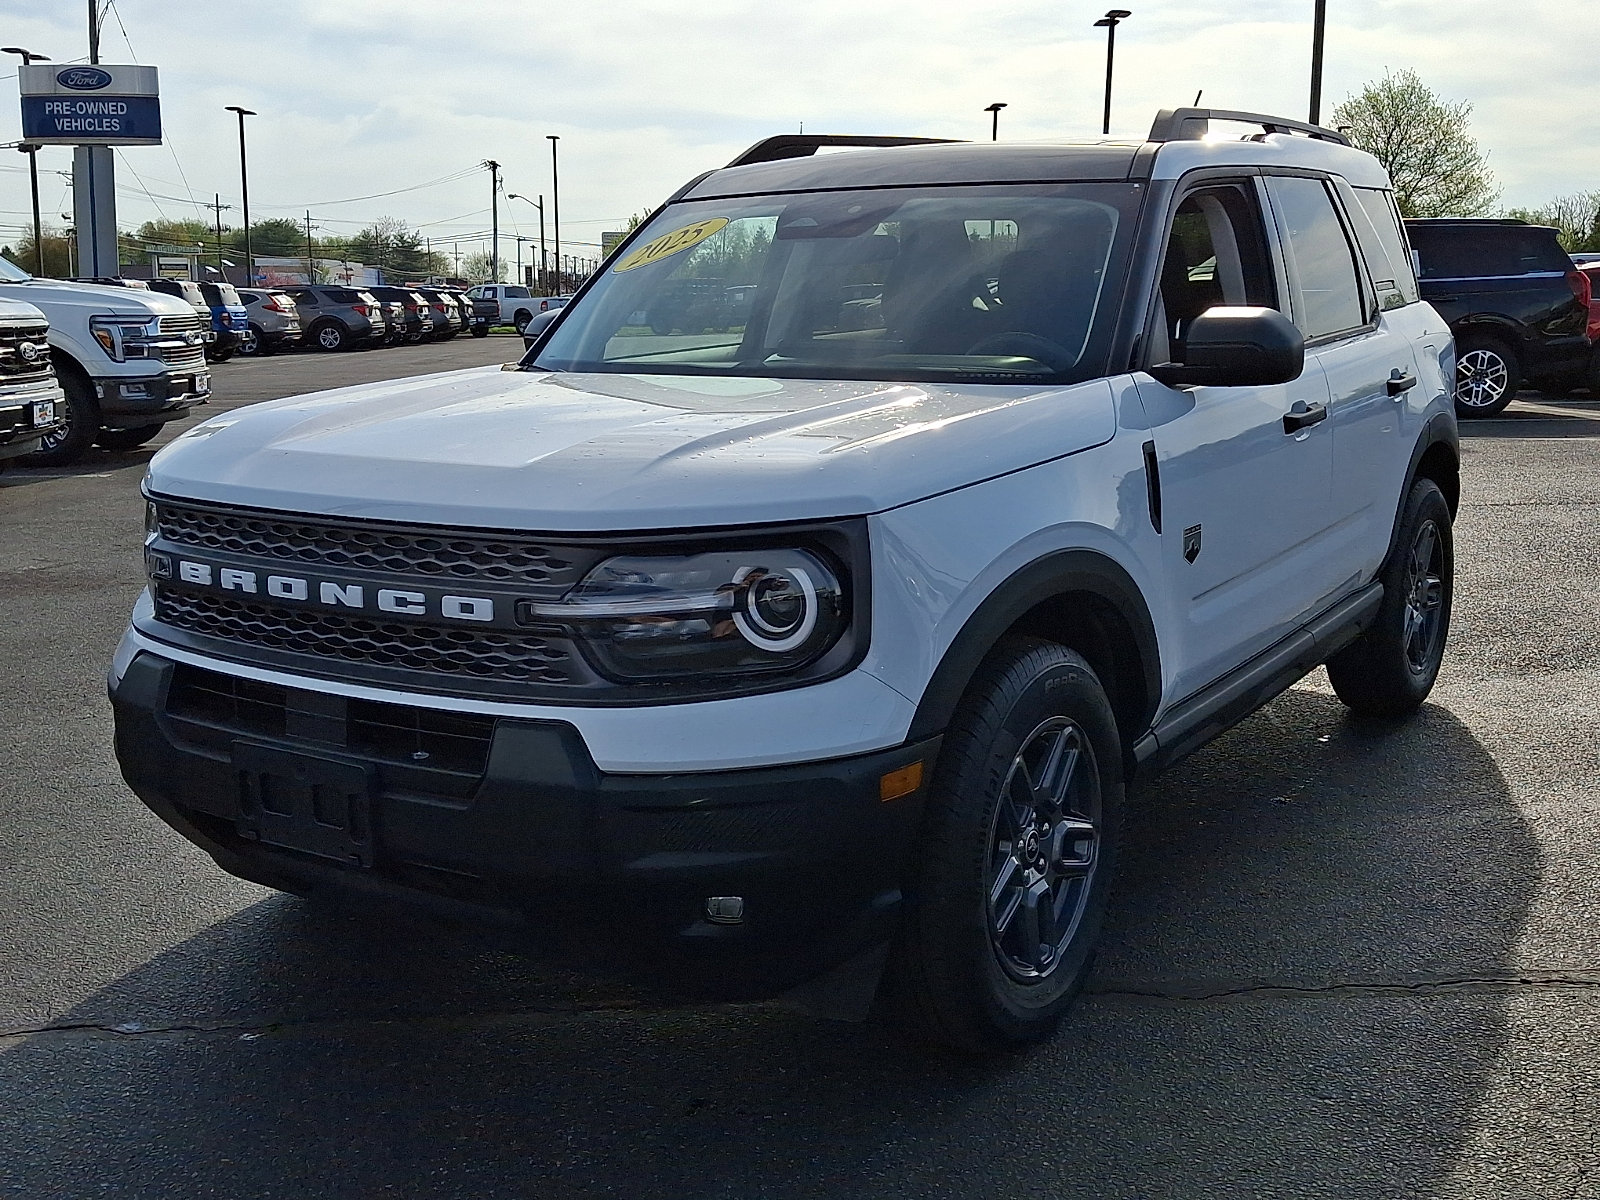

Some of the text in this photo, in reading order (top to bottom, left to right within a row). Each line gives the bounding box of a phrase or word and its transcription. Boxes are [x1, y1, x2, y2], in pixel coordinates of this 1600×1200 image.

[67, 71, 99, 86] Ford
[45, 102, 127, 115] PRE-OWNED
[55, 118, 120, 131] VEHICLES
[626, 220, 712, 268] 2025
[179, 560, 494, 622] BRONCO
